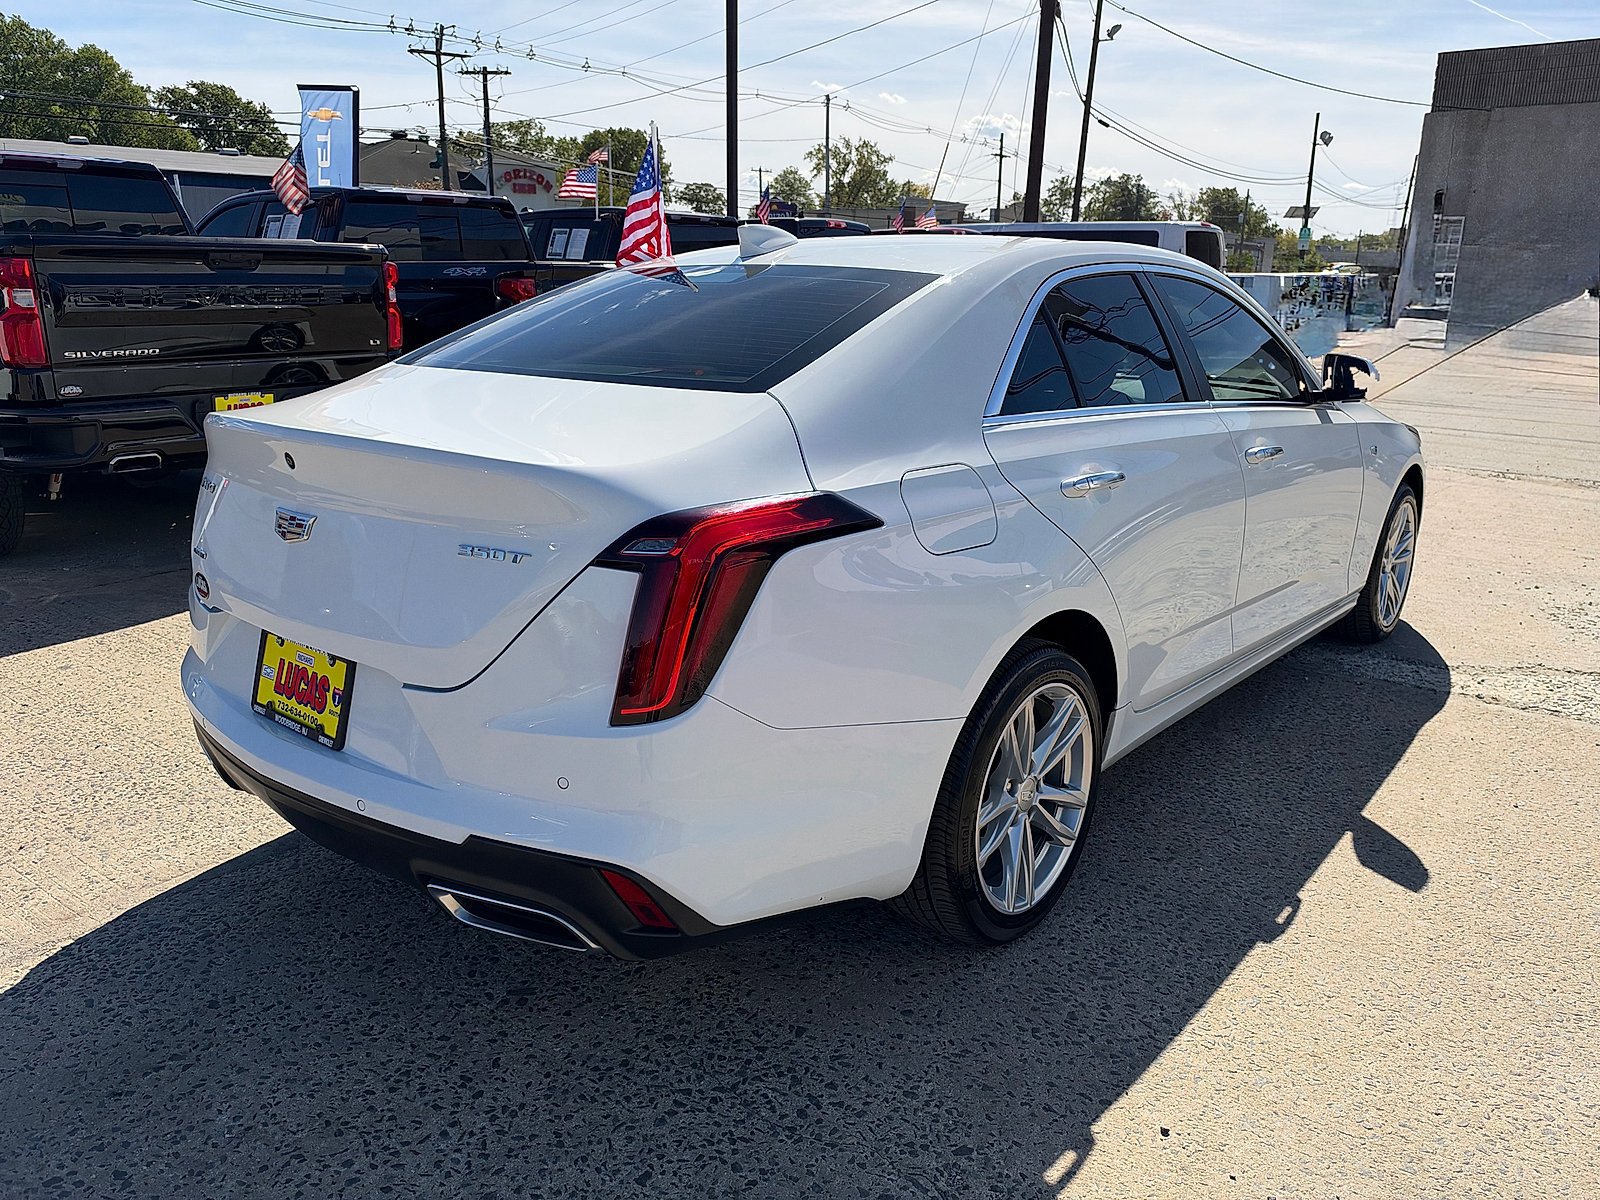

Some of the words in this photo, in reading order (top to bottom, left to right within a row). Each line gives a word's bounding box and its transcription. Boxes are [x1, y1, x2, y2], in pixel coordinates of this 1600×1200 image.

[63, 348, 160, 359] SILVERADO
[457, 545, 532, 564] 350T
[297, 652, 314, 666] RICHARD
[273, 657, 331, 714] LUCAS
[277, 699, 320, 727] 732-634-0100
[301, 726, 309, 736] NJ
